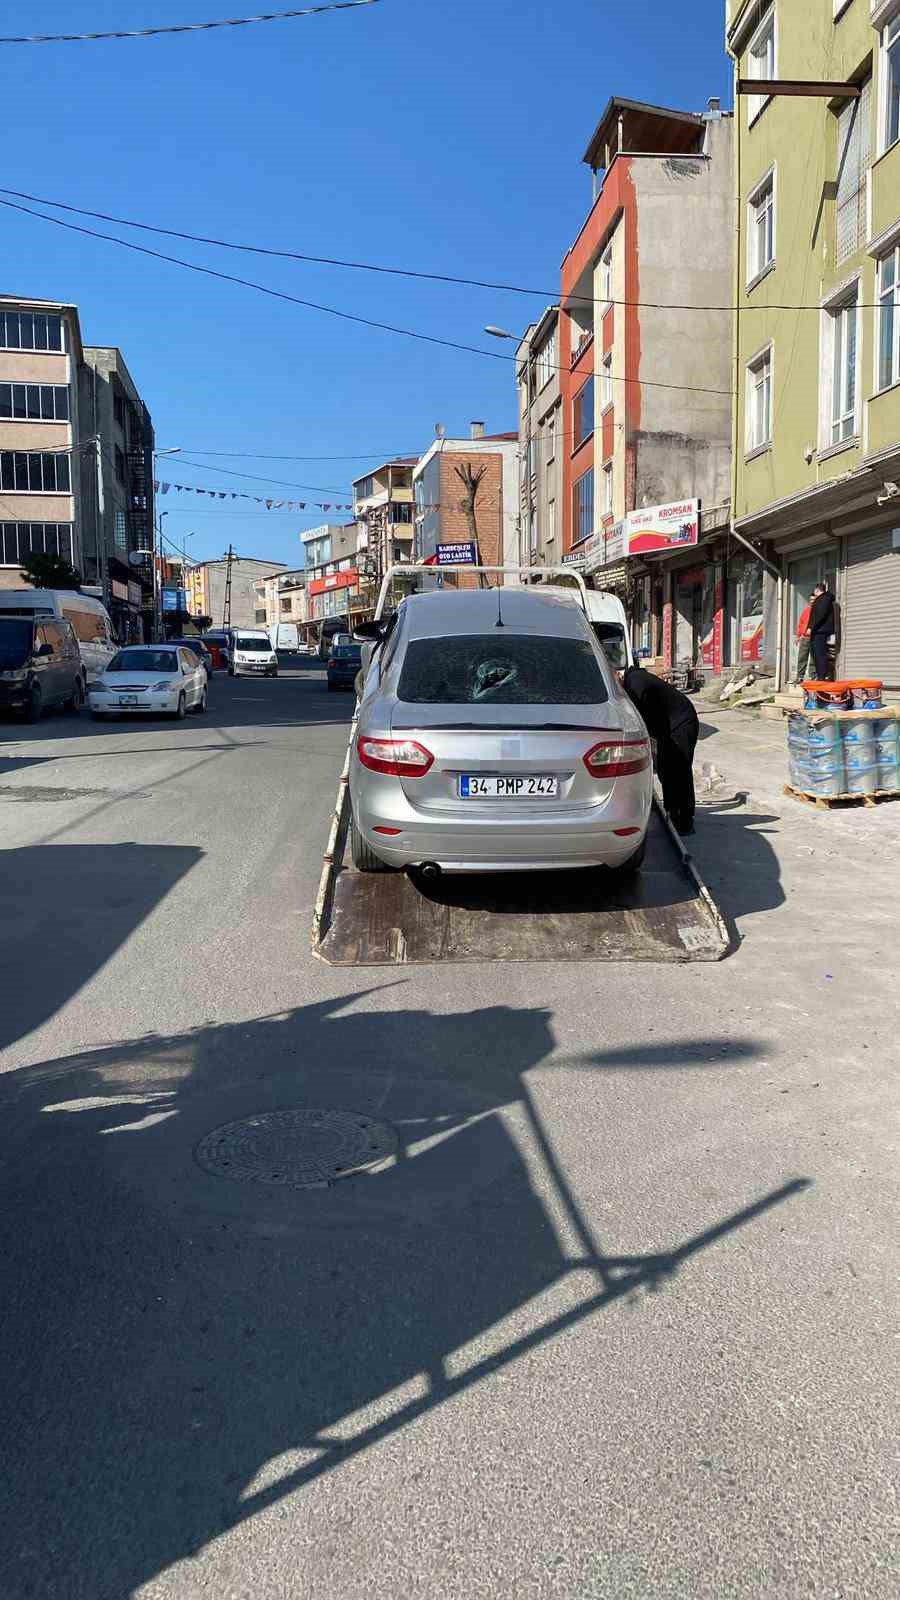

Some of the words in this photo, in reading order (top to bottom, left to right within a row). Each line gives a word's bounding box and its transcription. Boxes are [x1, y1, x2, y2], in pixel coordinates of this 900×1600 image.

[659, 504, 692, 518] KROMSAN
[471, 779, 488, 794] 34
[496, 779, 523, 794] PMP
[528, 778, 554, 794] 242
